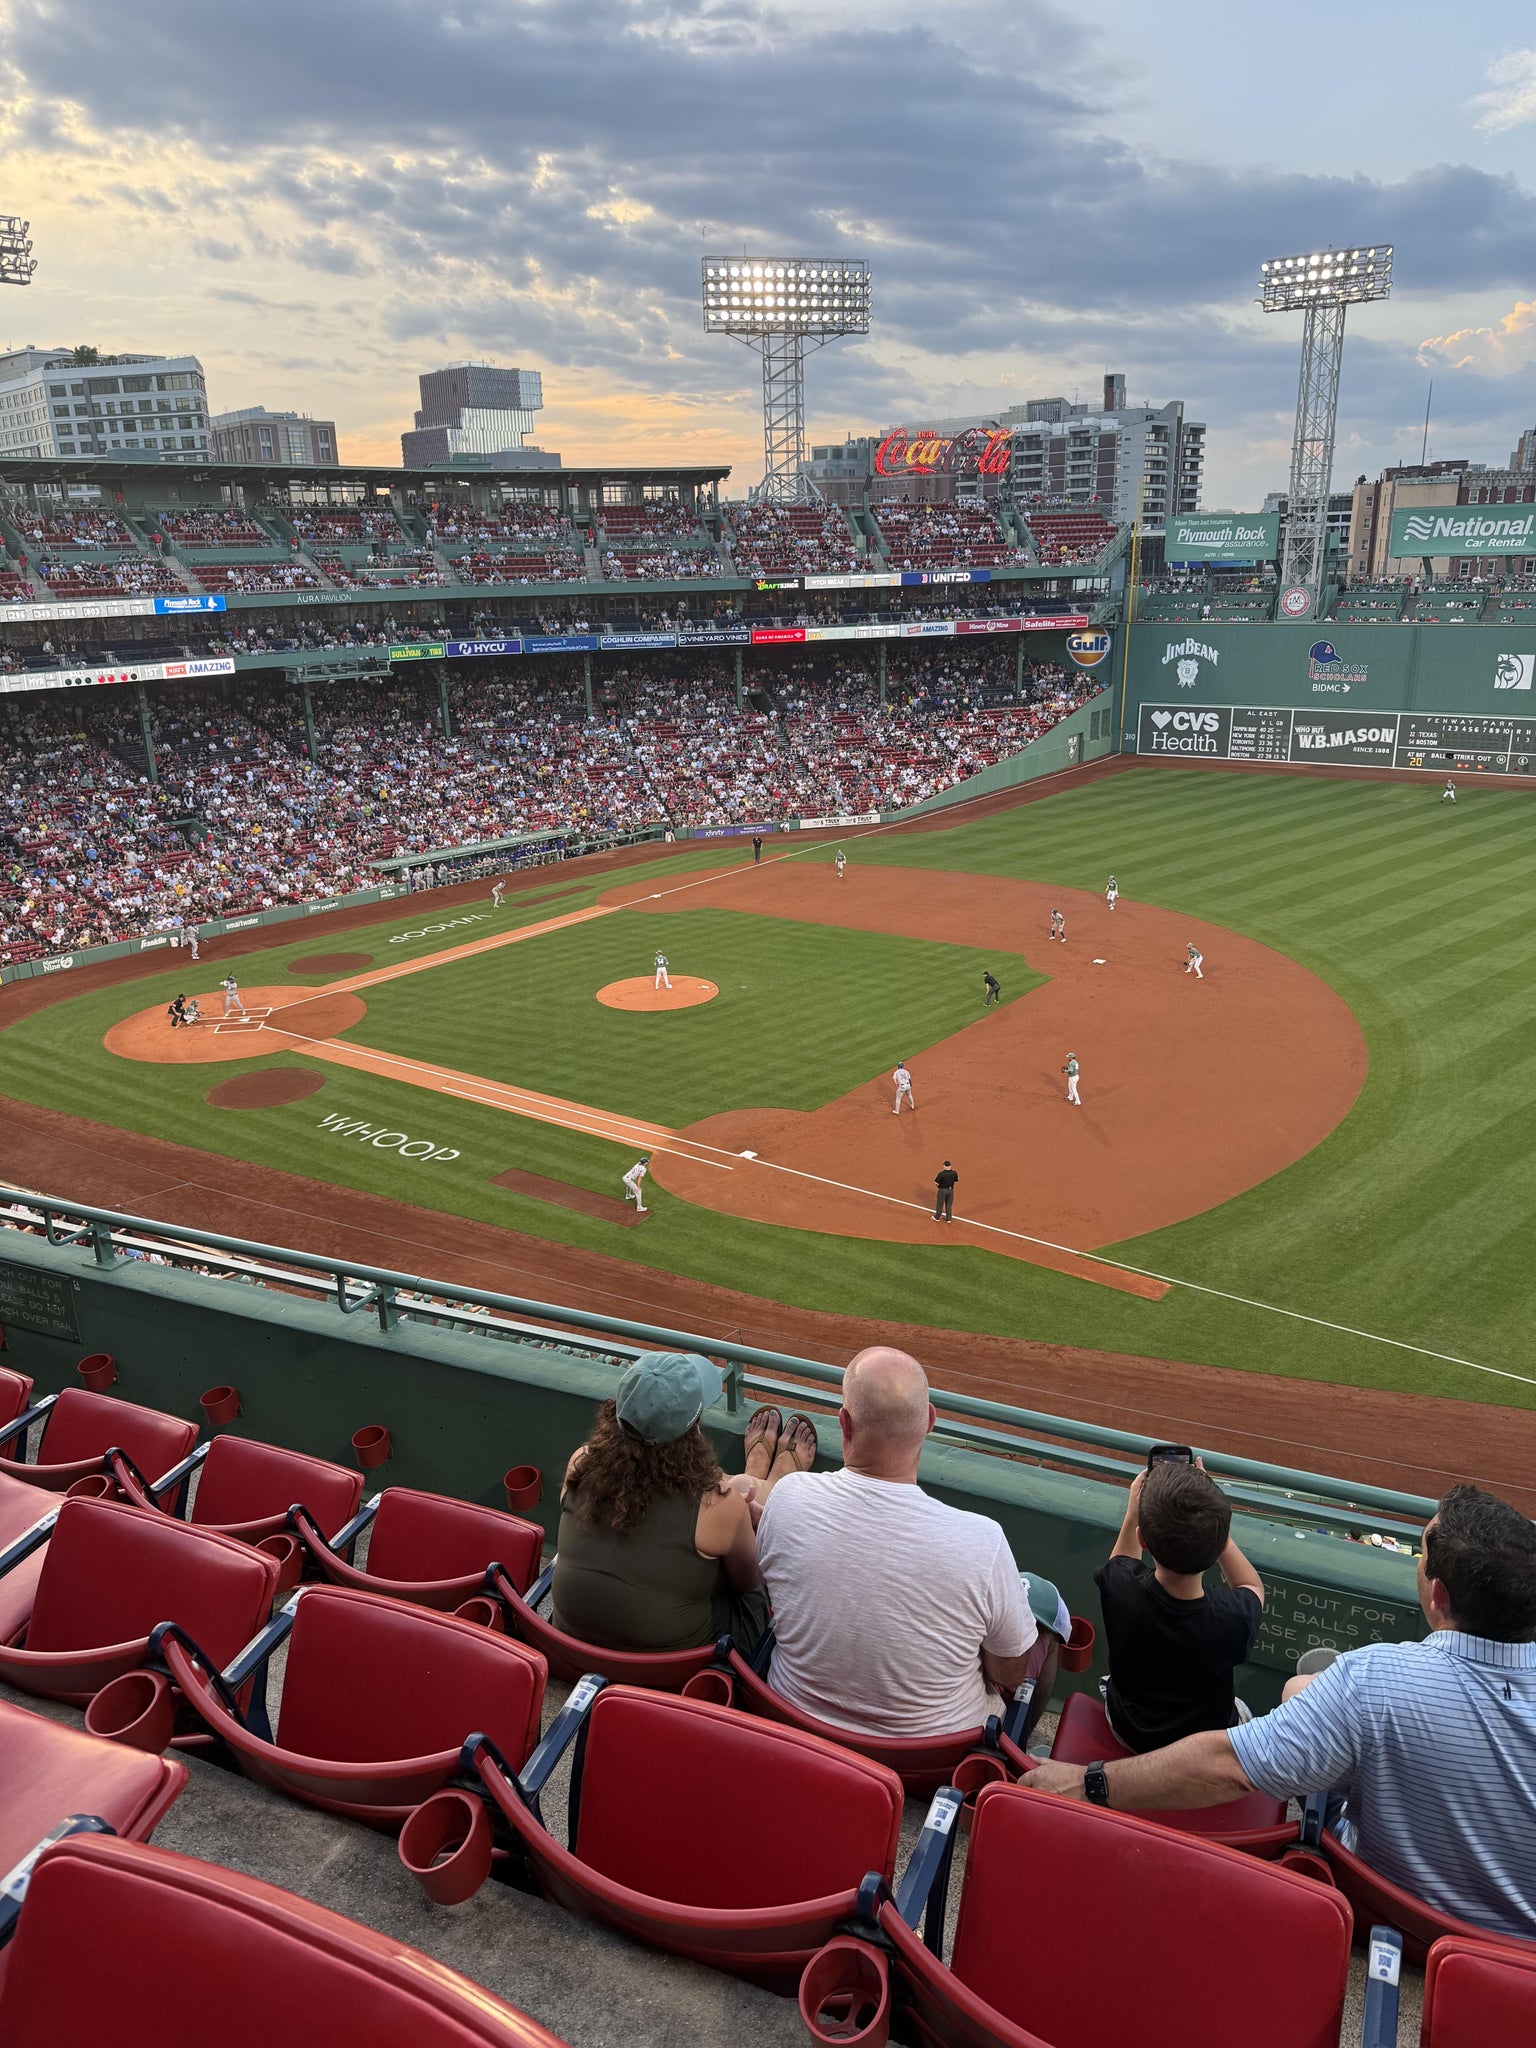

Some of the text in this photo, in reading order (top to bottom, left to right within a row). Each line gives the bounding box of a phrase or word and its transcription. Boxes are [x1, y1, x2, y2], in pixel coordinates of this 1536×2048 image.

[874, 427, 1017, 477] Coca-Cola
[1177, 526, 1266, 543] Plymouth Rock
[1465, 538, 1526, 548] Car Rental
[932, 572, 971, 583] UNITED
[321, 593, 351, 602] PAVILION
[922, 625, 948, 633] AMAZING
[602, 635, 675, 644] COGHLIN COMPANIES
[1068, 636, 1108, 650] Gulf
[391, 647, 442, 658] SULLIVAN TIRE
[474, 643, 505, 653] HYCU
[1161, 637, 1220, 666] JIM BEAM
[189, 662, 231, 673] AMAZING
[1314, 664, 1368, 674] RED SOX
[1313, 673, 1367, 682] SCHOLARS
[1312, 684, 1340, 693] BIDMC
[1172, 712, 1220, 732] CVS
[1151, 732, 1218, 752] Health
[1409, 758, 1422, 767] 20
[225, 918, 259, 930] smartwater
[389, 915, 492, 944] WHOOP
[140, 937, 167, 949] Franklin
[43, 964, 61, 972] Nine
[316, 1113, 460, 1161] WHOOP
[18, 1272, 37, 1283] OUT
[42, 1278, 62, 1289] FOR
[20, 1285, 49, 1300] BALLS
[29, 1302, 43, 1311] DO
[47, 1304, 67, 1316] NOT
[23, 1312, 49, 1325] OVER
[54, 1320, 75, 1332] RAIL
[1298, 1594, 1341, 1612] OUT
[1351, 1605, 1396, 1626] FOR
[1293, 1612, 1359, 1636] BALLS
[1370, 1629, 1384, 1642] &
[1308, 1634, 1337, 1649] DO
